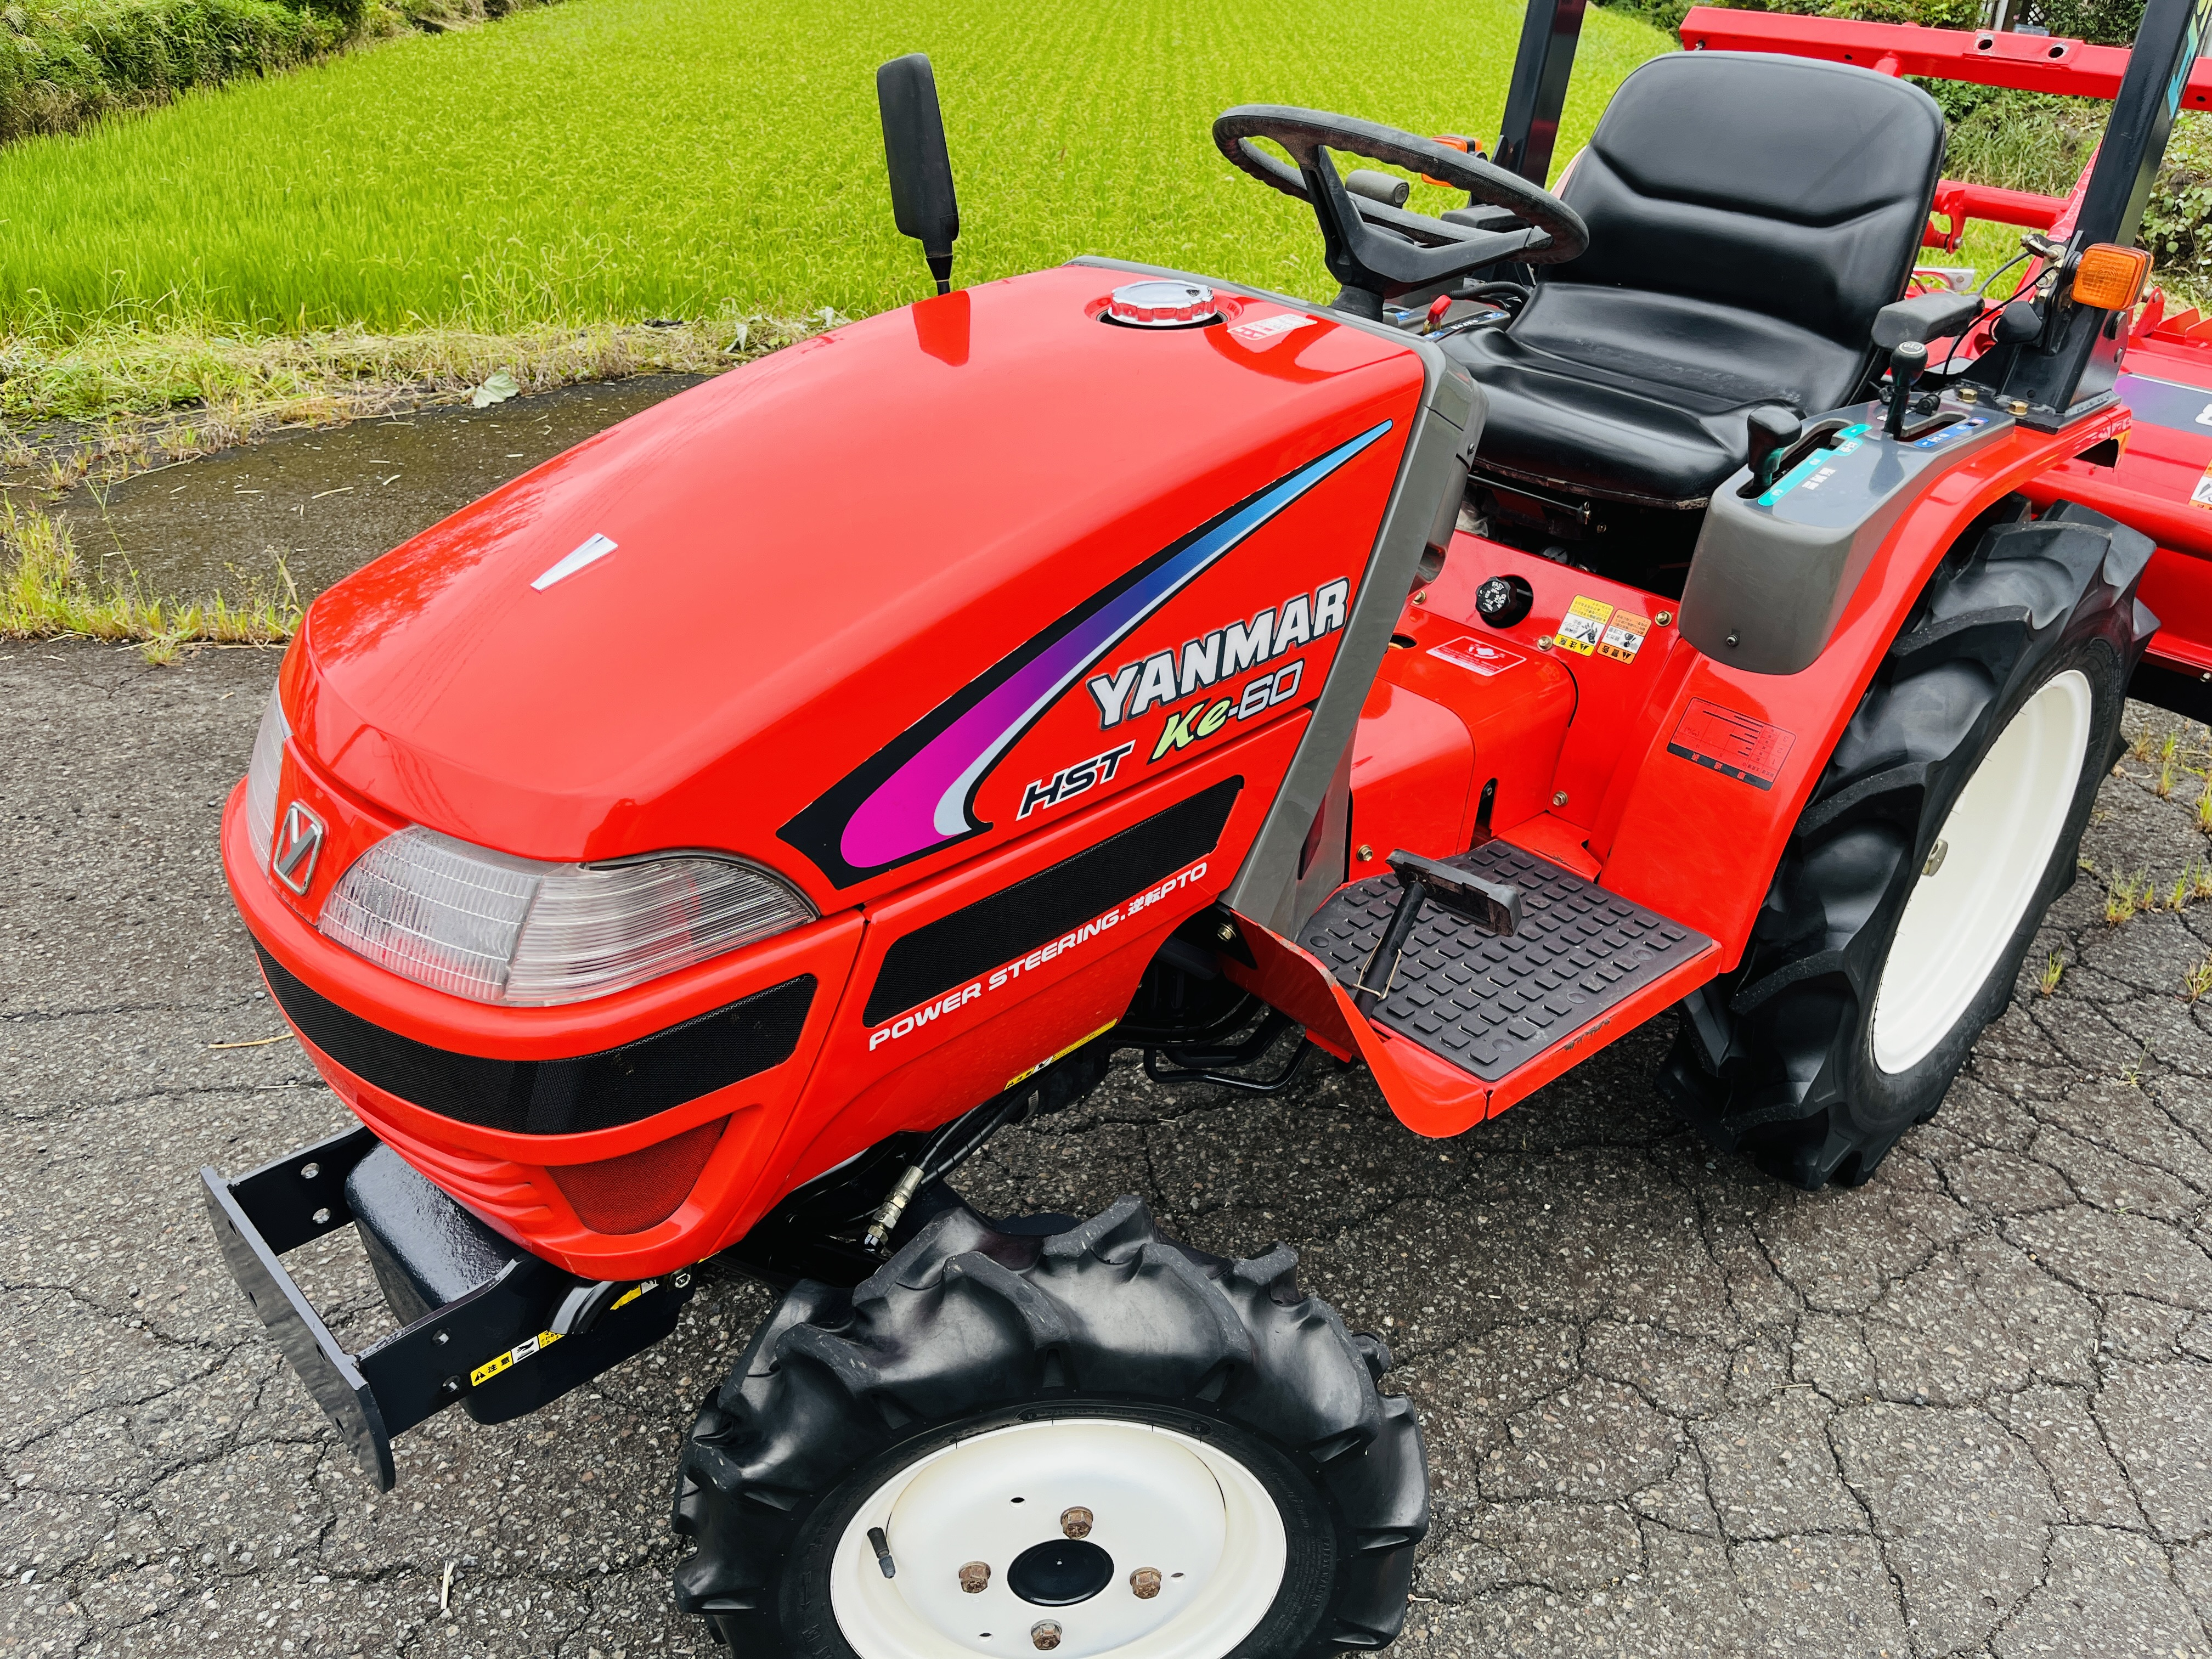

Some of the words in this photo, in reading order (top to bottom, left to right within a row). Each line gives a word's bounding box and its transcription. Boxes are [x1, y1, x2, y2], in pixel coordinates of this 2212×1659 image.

[1087, 577, 1350, 730] YANMAR
[1147, 658, 1305, 765] Ke-60
[1015, 738, 1136, 822] HST
[869, 982, 982, 1052] POWER
[488, 1356, 510, 1373] 注意
